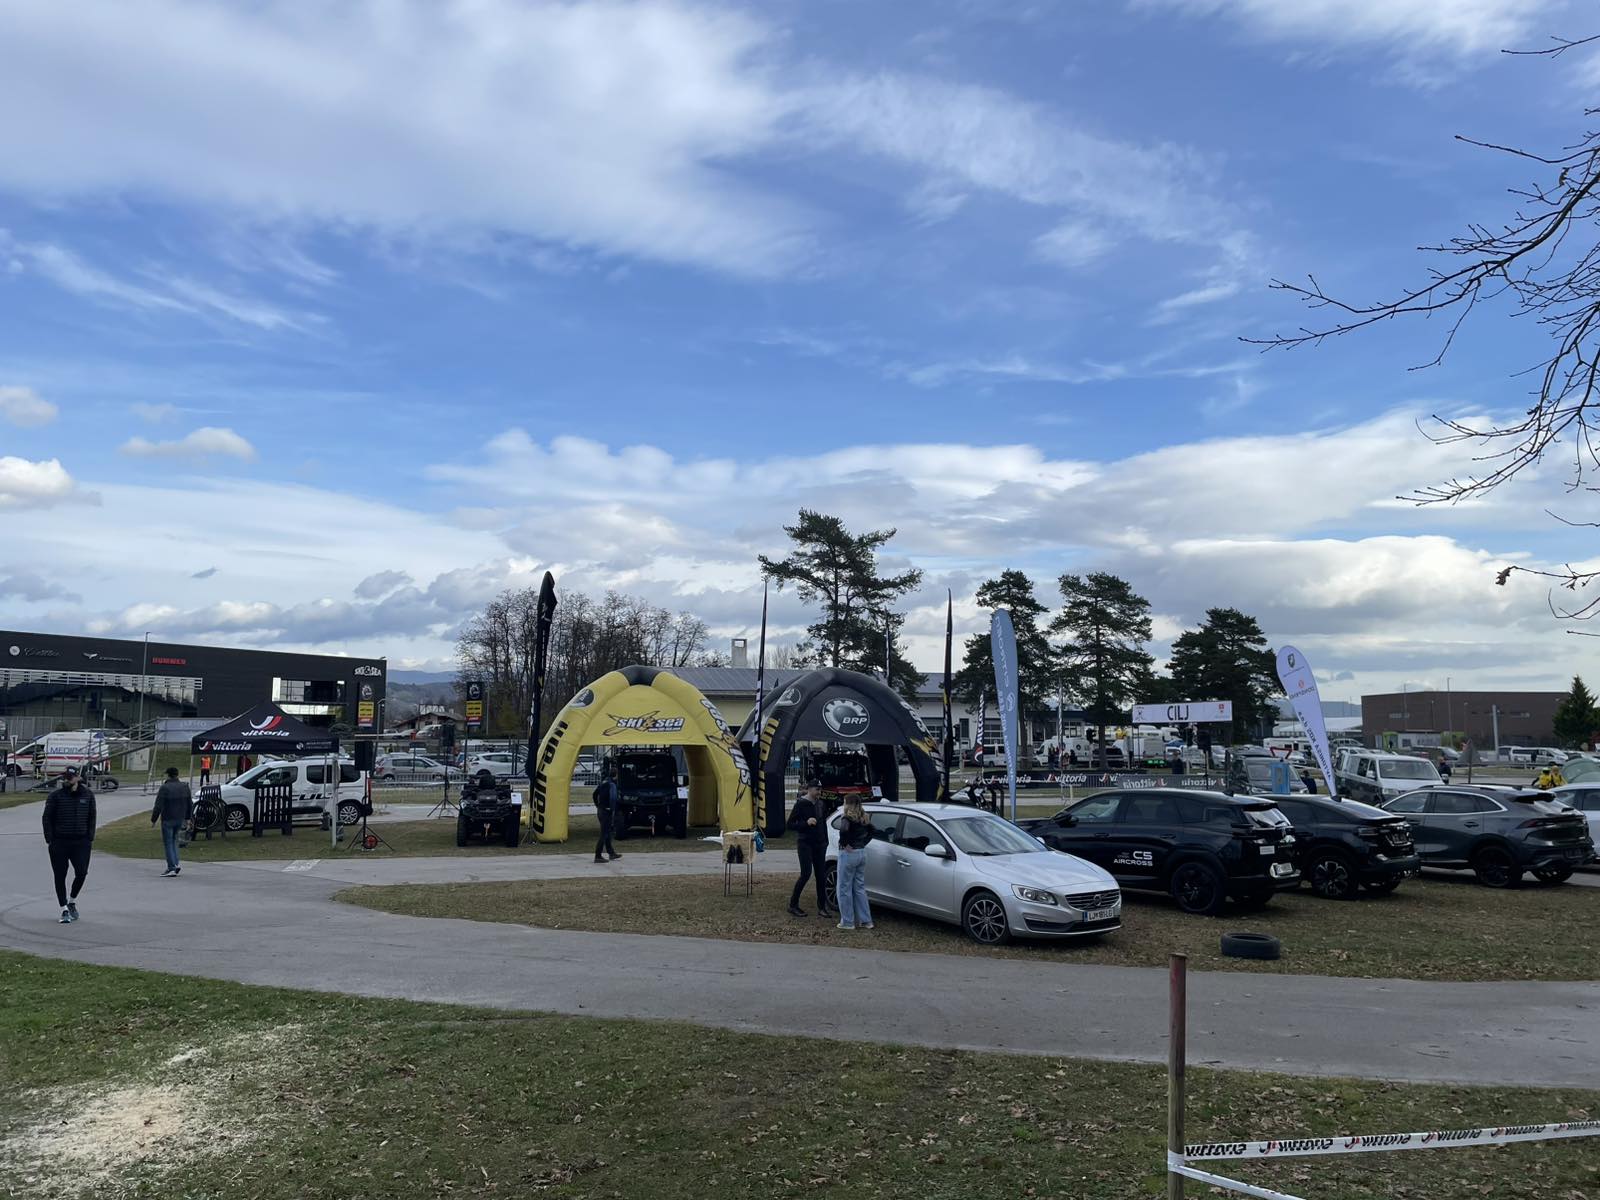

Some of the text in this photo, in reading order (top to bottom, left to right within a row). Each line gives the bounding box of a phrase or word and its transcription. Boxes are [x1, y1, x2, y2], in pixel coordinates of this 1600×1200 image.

[1167, 705, 1189, 721] CILJ
[842, 717, 868, 725] BRP
[241, 729, 290, 737] vittoria
[212, 741, 252, 751] vittoria
[532, 720, 569, 834] can-am
[1055, 773, 1087, 784] vittoria
[1133, 851, 1153, 860] C5
[1113, 858, 1153, 867] AIRCROSS
